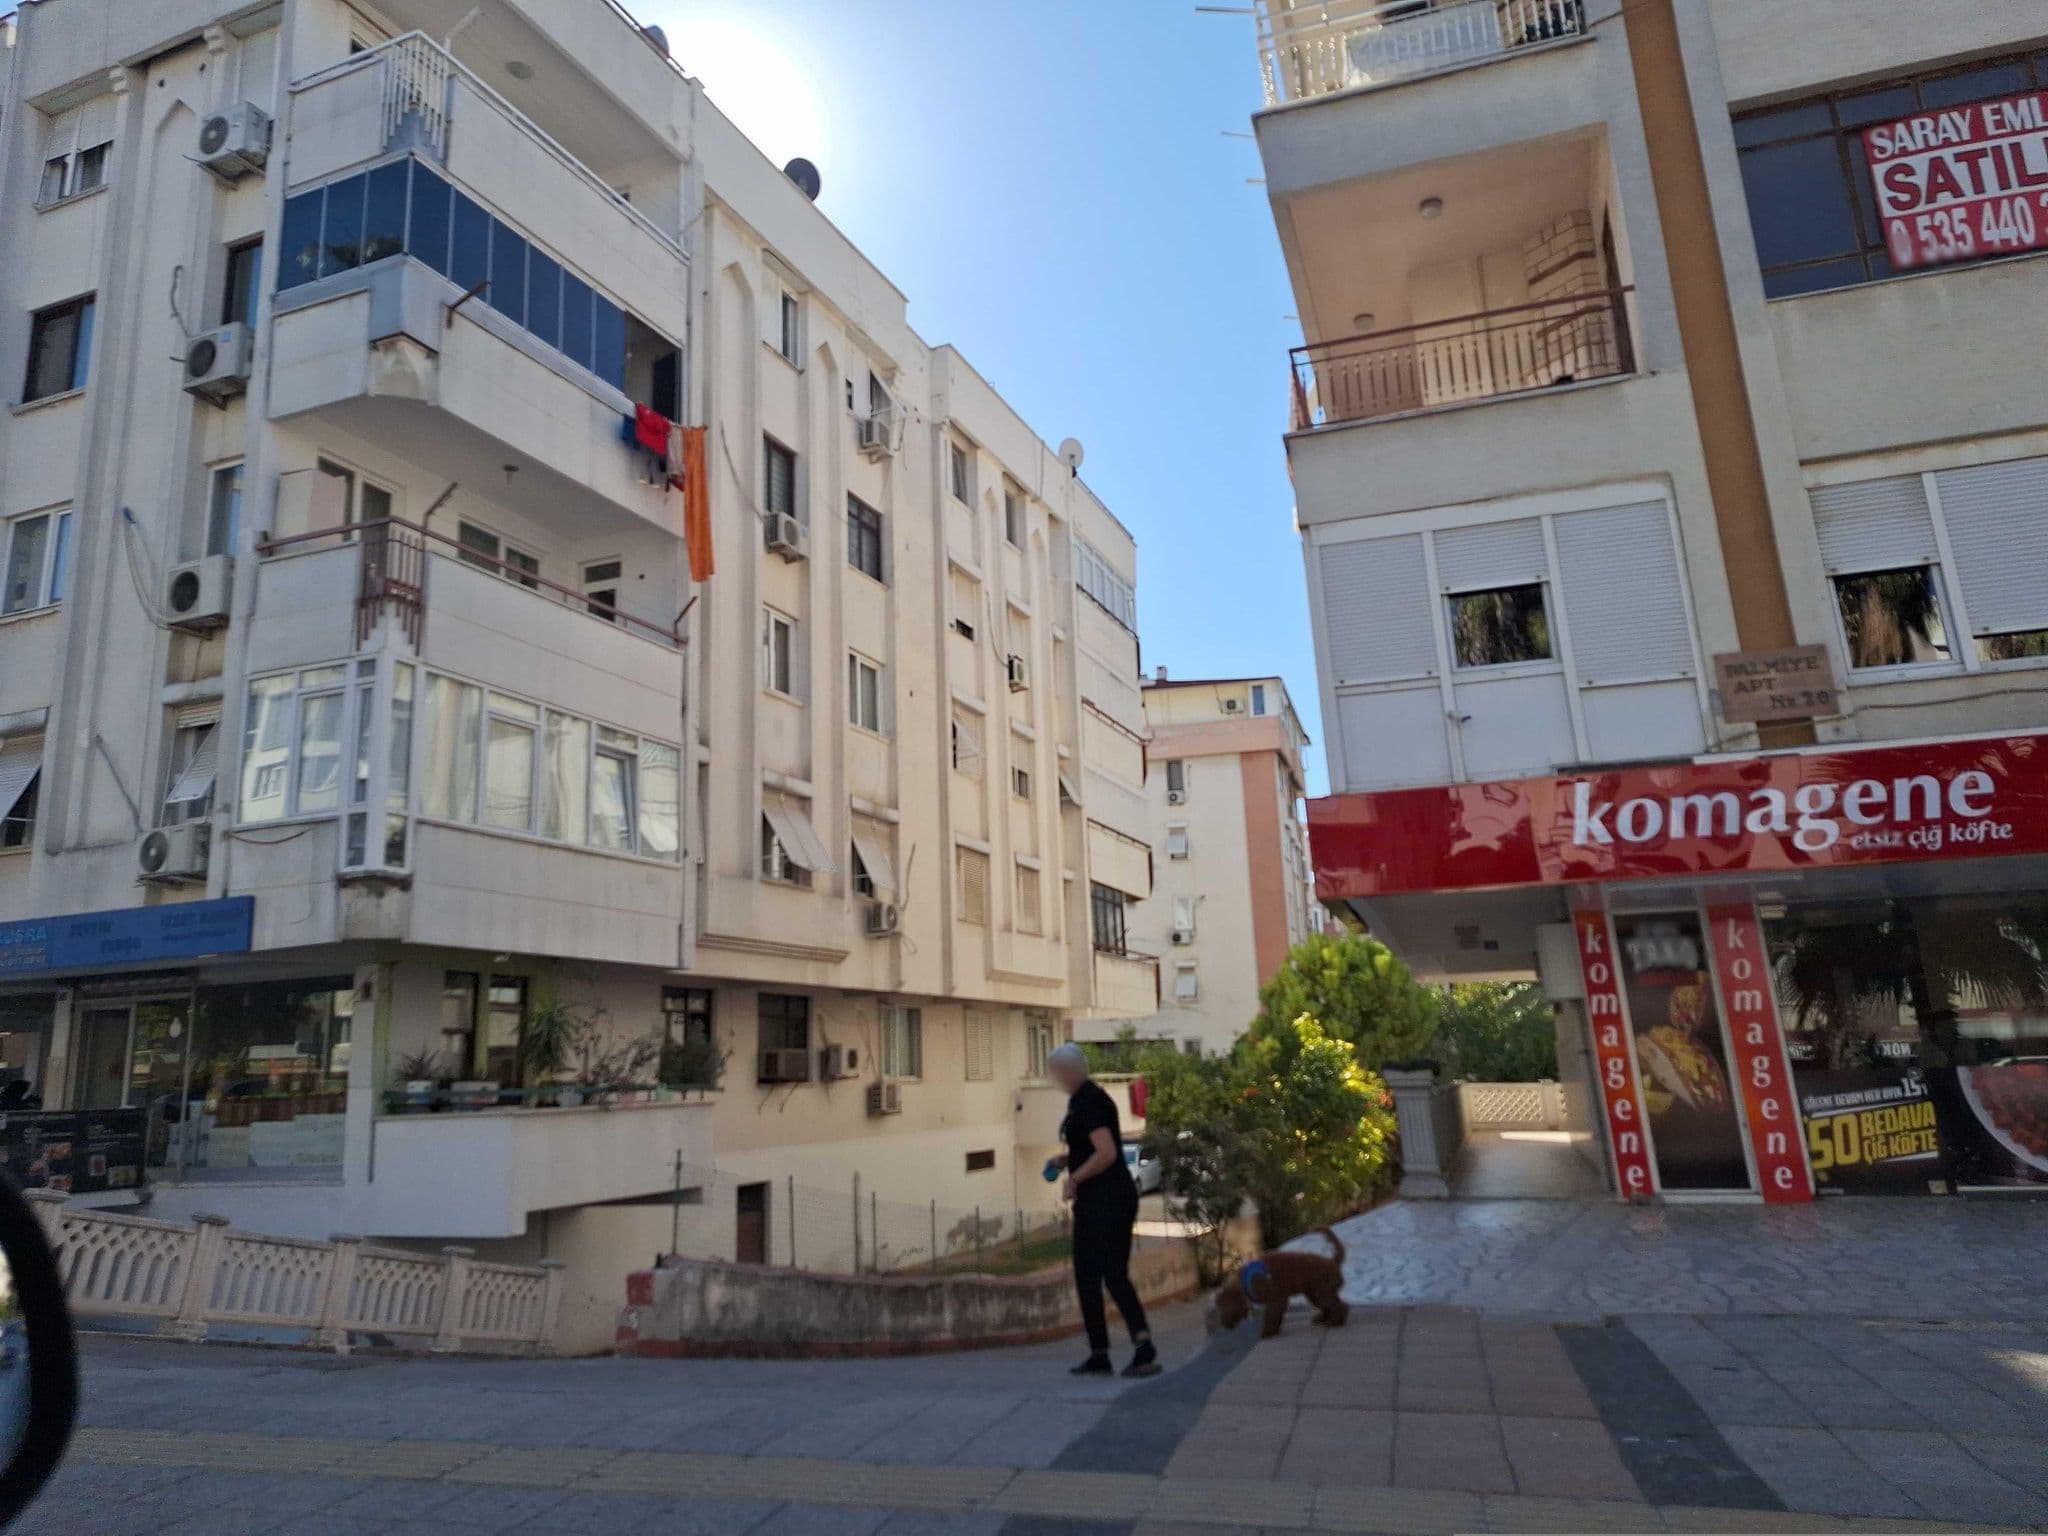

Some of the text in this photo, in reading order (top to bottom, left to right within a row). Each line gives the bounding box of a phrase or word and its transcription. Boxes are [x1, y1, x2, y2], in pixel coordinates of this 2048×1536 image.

[1871, 97, 2048, 160] SARAY EML
[1883, 138, 2048, 212] SATIL
[1890, 218, 1912, 268] 0
[1917, 210, 1974, 260] 535
[1981, 196, 2036, 249] 440
[1734, 677, 1777, 694] APT
[1573, 769, 1995, 852] komagene
[1908, 824, 1943, 852] çiğ
[1949, 820, 2014, 844] köfte
[1585, 924, 1646, 1188] komagene
[1727, 918, 1793, 1189] komagene
[1808, 1113, 1861, 1169] 50
[1861, 1100, 1937, 1138] BEDAVA
[1889, 1129, 1939, 1157] KÖFTE
